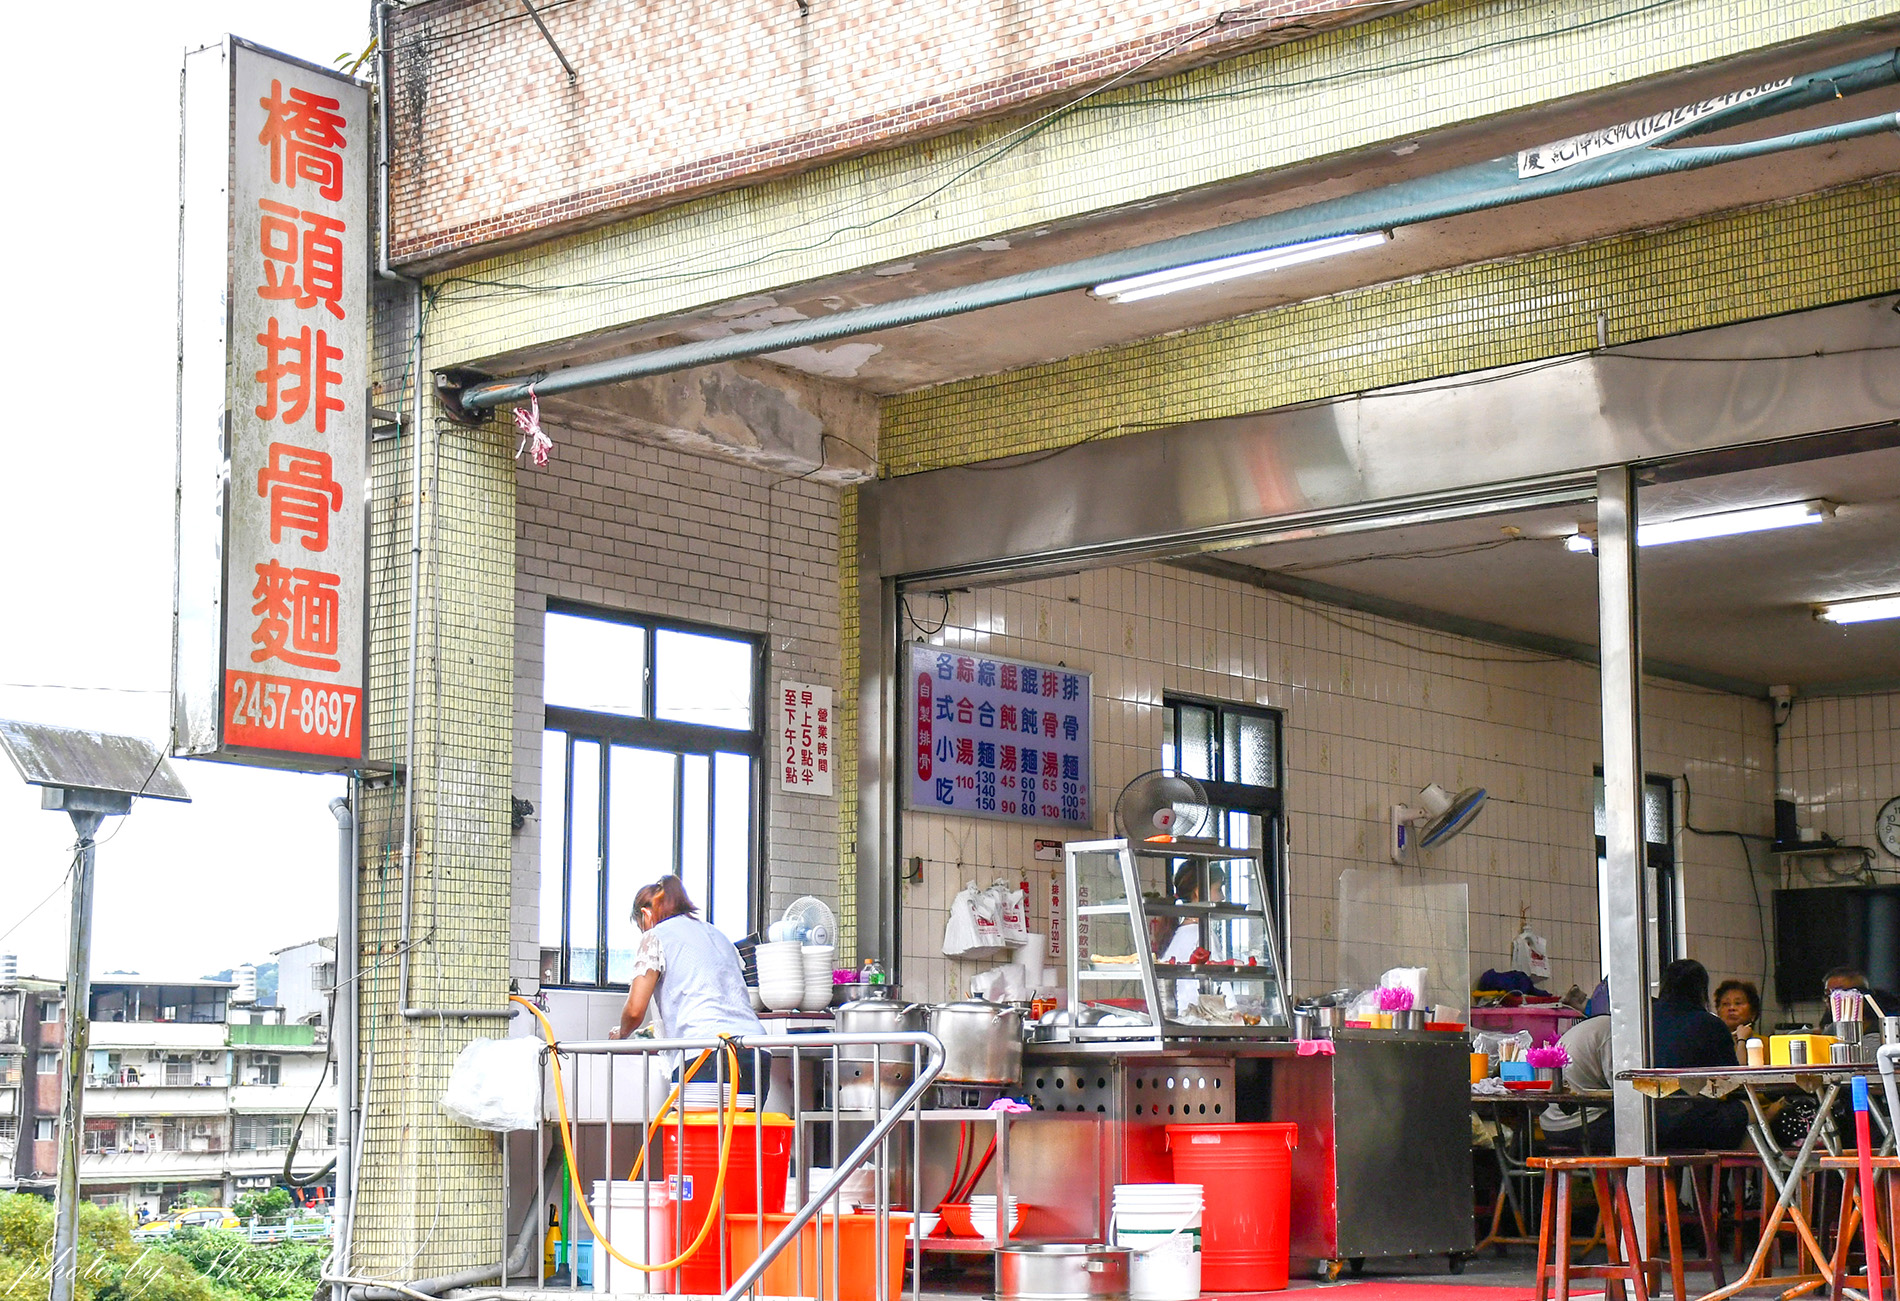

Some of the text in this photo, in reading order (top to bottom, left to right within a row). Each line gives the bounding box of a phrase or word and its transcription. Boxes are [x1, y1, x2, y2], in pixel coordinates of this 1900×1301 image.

[251, 78, 347, 673] 橋頭排骨麵
[232, 678, 357, 738] 2457-8697
[785, 689, 797, 784] 至下午2點
[801, 690, 814, 785] 早上5點半
[817, 707, 828, 773] 營業時間
[919, 683, 931, 770] 自製排骨
[936, 653, 954, 805] 各式小吃
[956, 656, 974, 790] 綜合湯 110
[976, 659, 996, 811] 綜合麵 130 140 150
[1000, 664, 1018, 814] 餛飩湯 45 90
[1021, 668, 1038, 816] 餛飩麵 60 70 80
[1042, 671, 1060, 819] 排骨湯 65 130
[1061, 674, 1079, 821] 排骨麵 90 100 110
